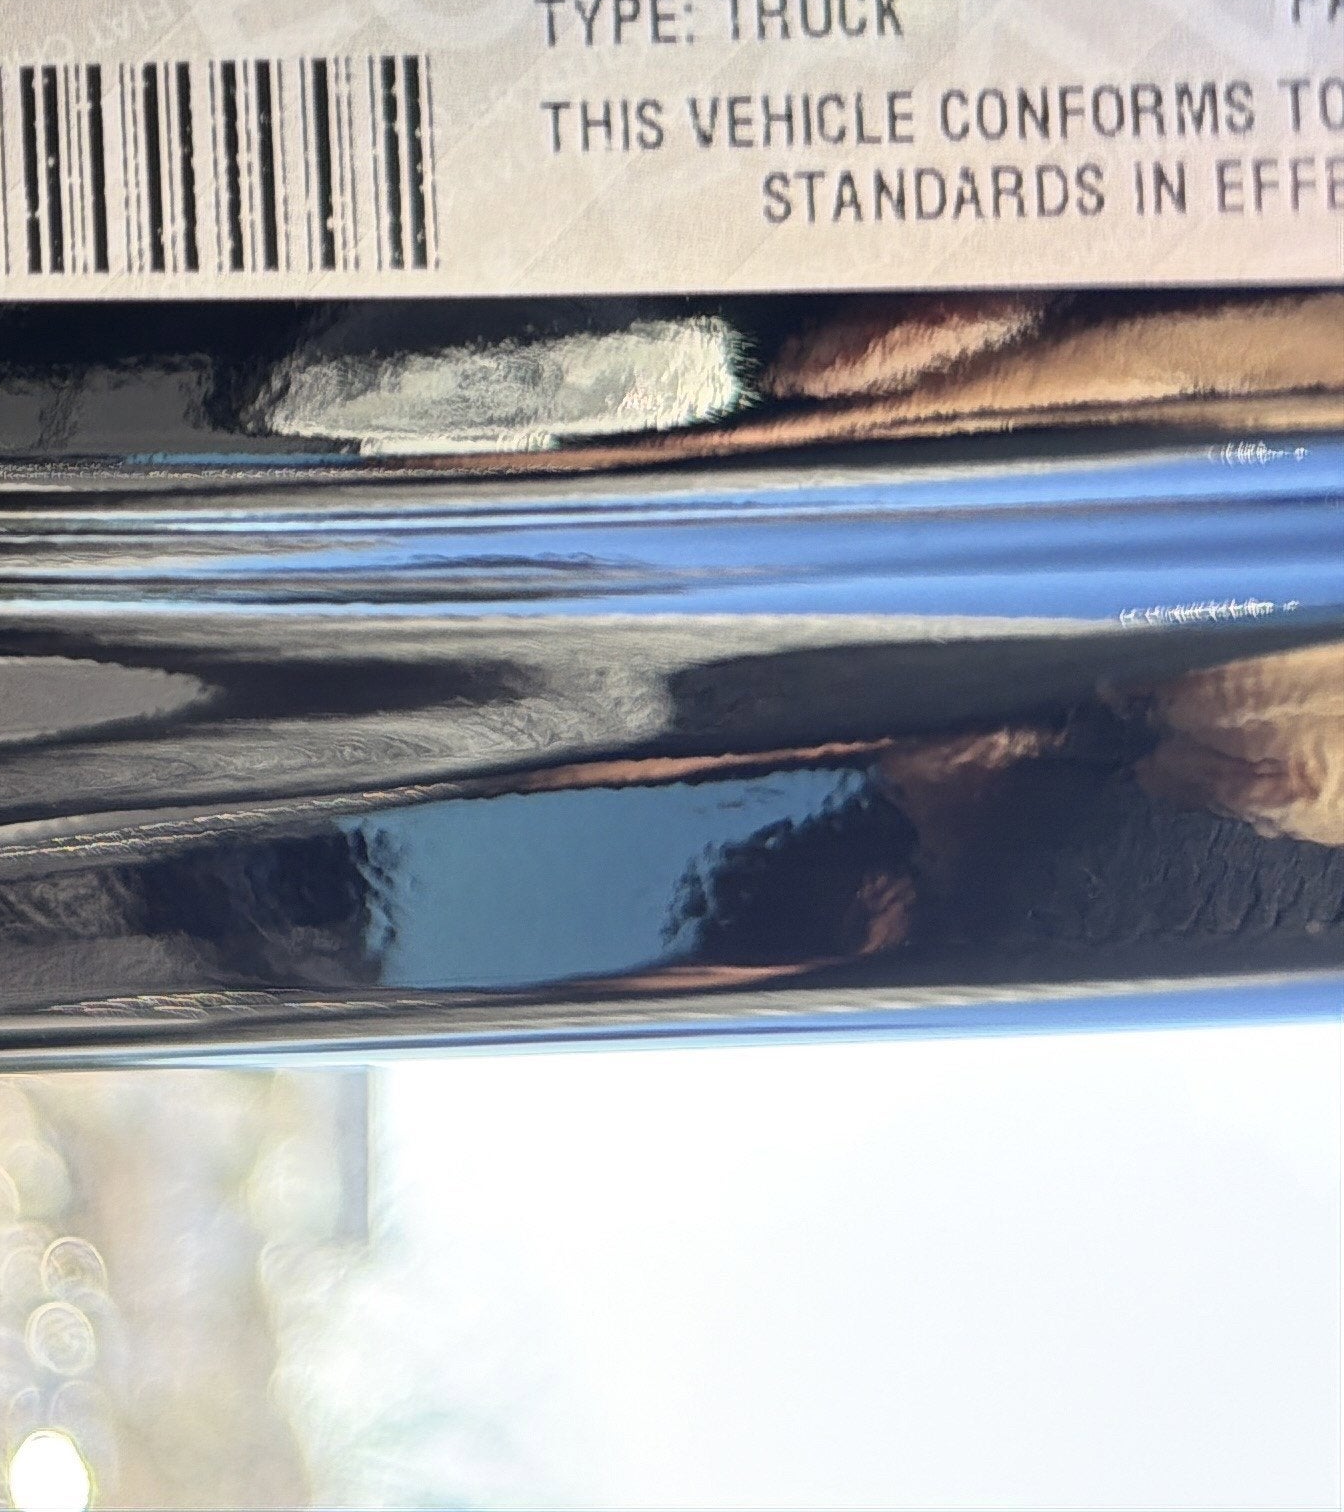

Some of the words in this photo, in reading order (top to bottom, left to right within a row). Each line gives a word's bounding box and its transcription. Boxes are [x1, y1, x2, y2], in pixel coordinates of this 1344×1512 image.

[541, 99, 664, 152] THIS
[690, 91, 913, 148] VEHICLE
[941, 81, 1254, 141] CONFORMS
[1279, 77, 1344, 132] TO
[764, 163, 1105, 223] STANDARDS
[1136, 162, 1186, 214] IN
